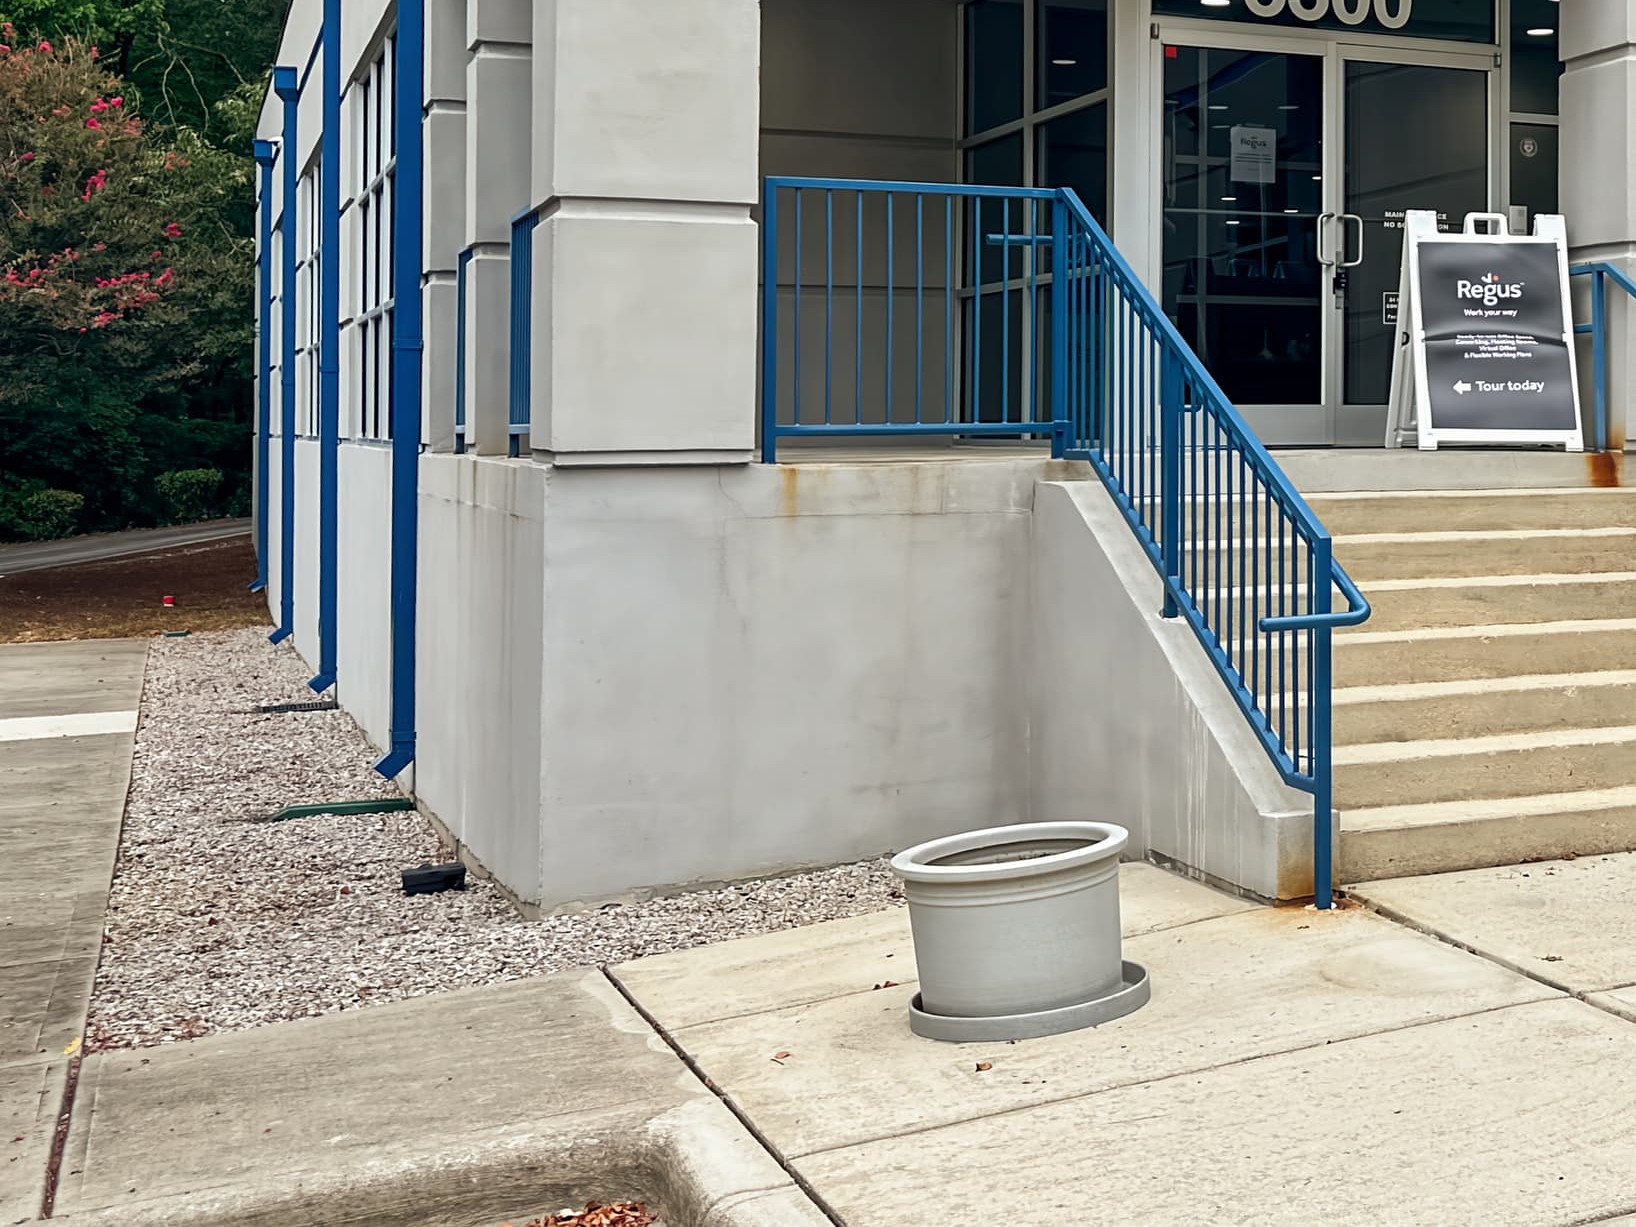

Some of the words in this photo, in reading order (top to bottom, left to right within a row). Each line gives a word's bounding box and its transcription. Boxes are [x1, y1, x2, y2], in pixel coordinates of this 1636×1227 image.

[1457, 280, 1522, 306] Regus
[1463, 308, 1483, 316] Work
[1484, 309, 1501, 317] your
[1502, 309, 1518, 317] way
[1475, 380, 1505, 391] Tour
[1507, 380, 1545, 393] today
